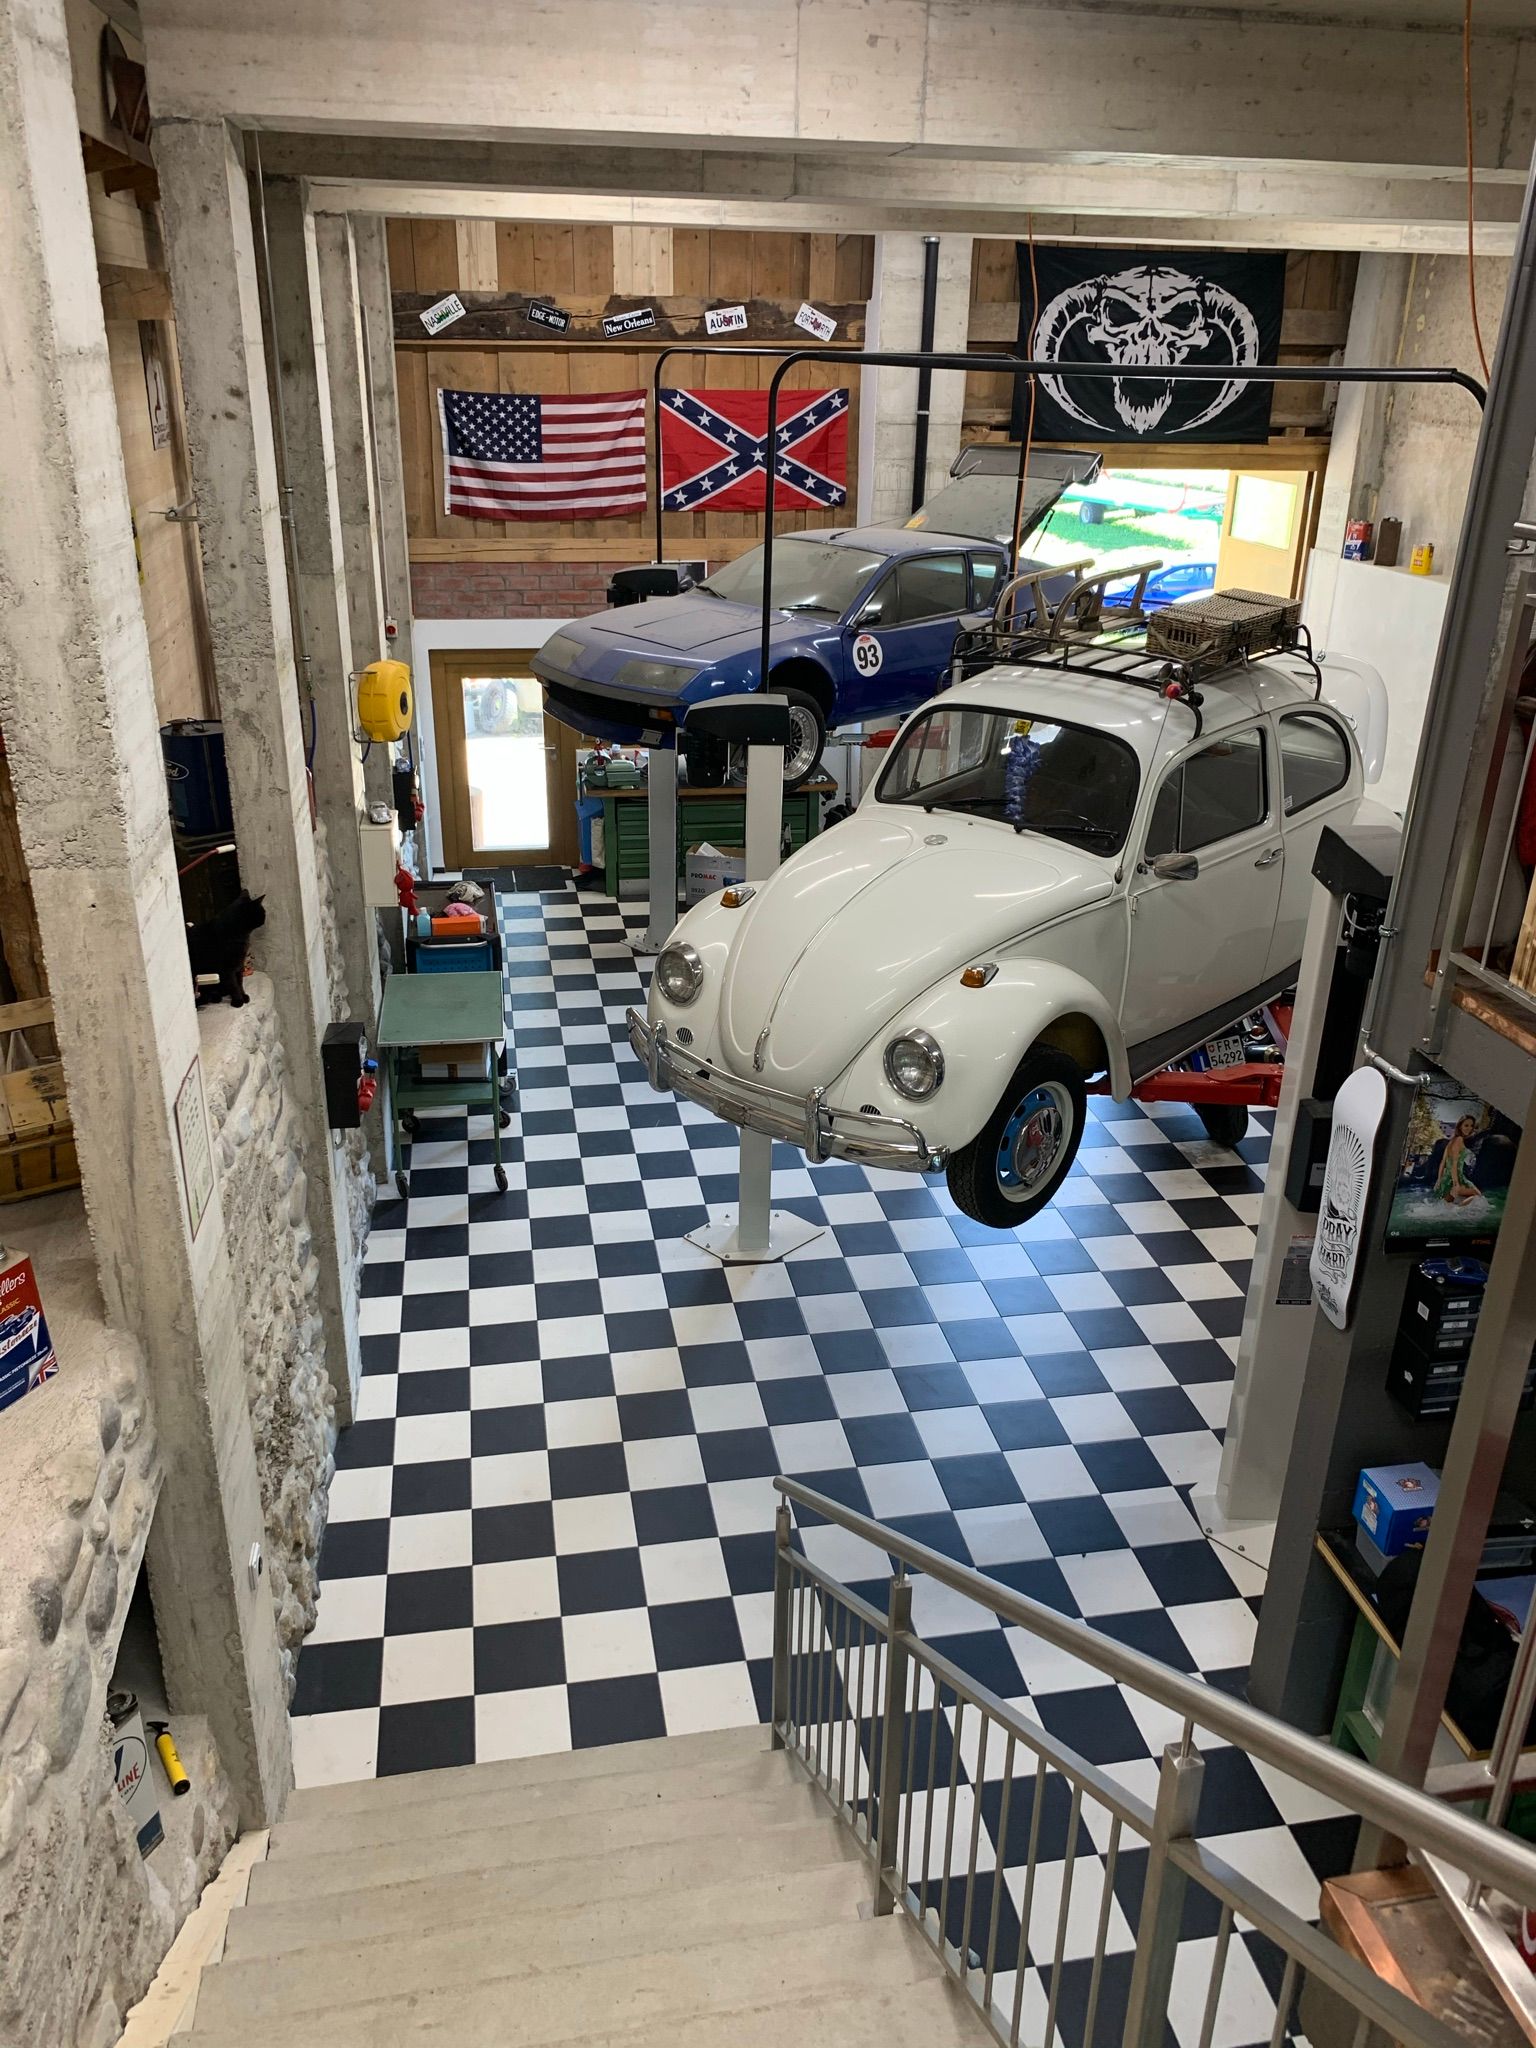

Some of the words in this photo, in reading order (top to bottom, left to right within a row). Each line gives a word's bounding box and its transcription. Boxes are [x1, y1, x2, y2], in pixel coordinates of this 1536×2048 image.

[424, 299, 462, 330] NASHVILLE
[605, 323, 623, 334] New
[623, 316, 653, 329] Orleans
[710, 313, 744, 330] AUSTIN
[857, 644, 880, 669] 93
[690, 872, 717, 880] PROMAC
[1216, 1039, 1231, 1052] FR
[1210, 1050, 1243, 1067] 54292
[1323, 1217, 1353, 1242] PRAY
[1320, 1245, 1346, 1269] HARD
[117, 1761, 140, 1792] LINE
